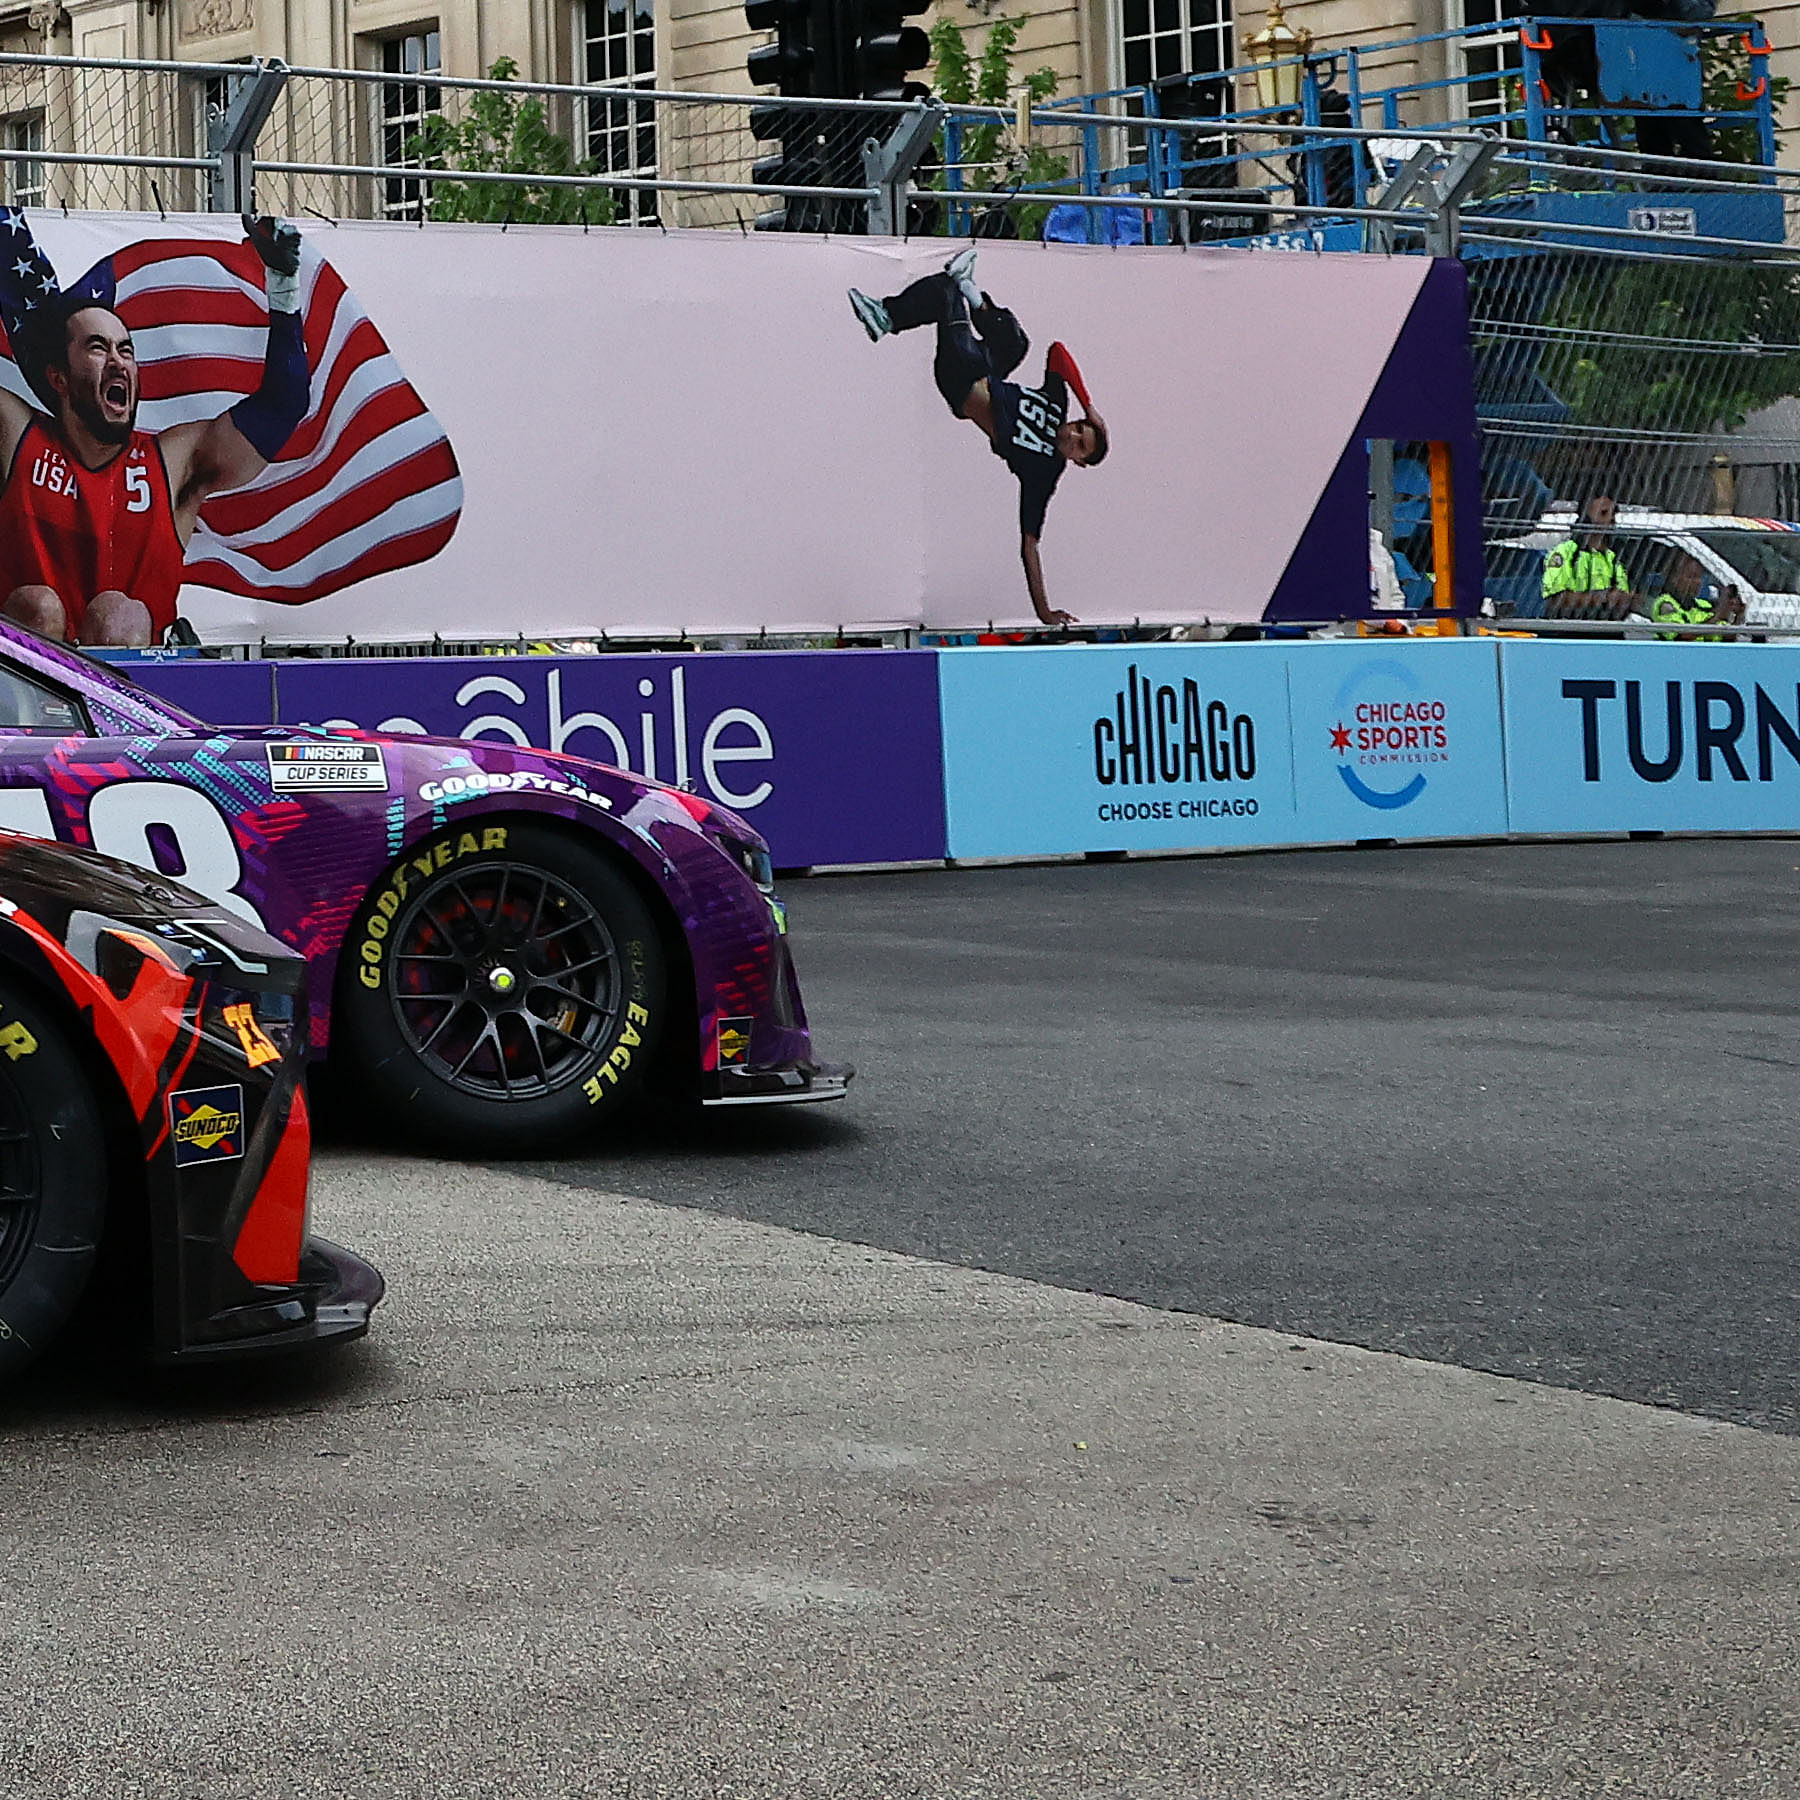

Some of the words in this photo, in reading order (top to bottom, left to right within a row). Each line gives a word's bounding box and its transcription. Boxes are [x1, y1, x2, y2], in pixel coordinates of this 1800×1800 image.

[32, 457, 79, 500] USA
[125, 465, 152, 513] 5
[140, 649, 178, 657] RECYCLE
[1094, 663, 1258, 786] CHICAGO
[1355, 701, 1446, 723] CHICAGO
[1357, 725, 1448, 751] SPORTS
[1561, 679, 1800, 783] TURN
[305, 747, 364, 761] NASCAR
[1359, 752, 1449, 766] COMMISSION
[287, 767, 316, 780] CUP
[318, 767, 368, 780] SERIES
[1098, 801, 1173, 822] CHOOSE
[1178, 798, 1259, 819] CHICAGO
[582, 1000, 649, 1105] EAGLE
[174, 1114, 241, 1143] SUNOCO
